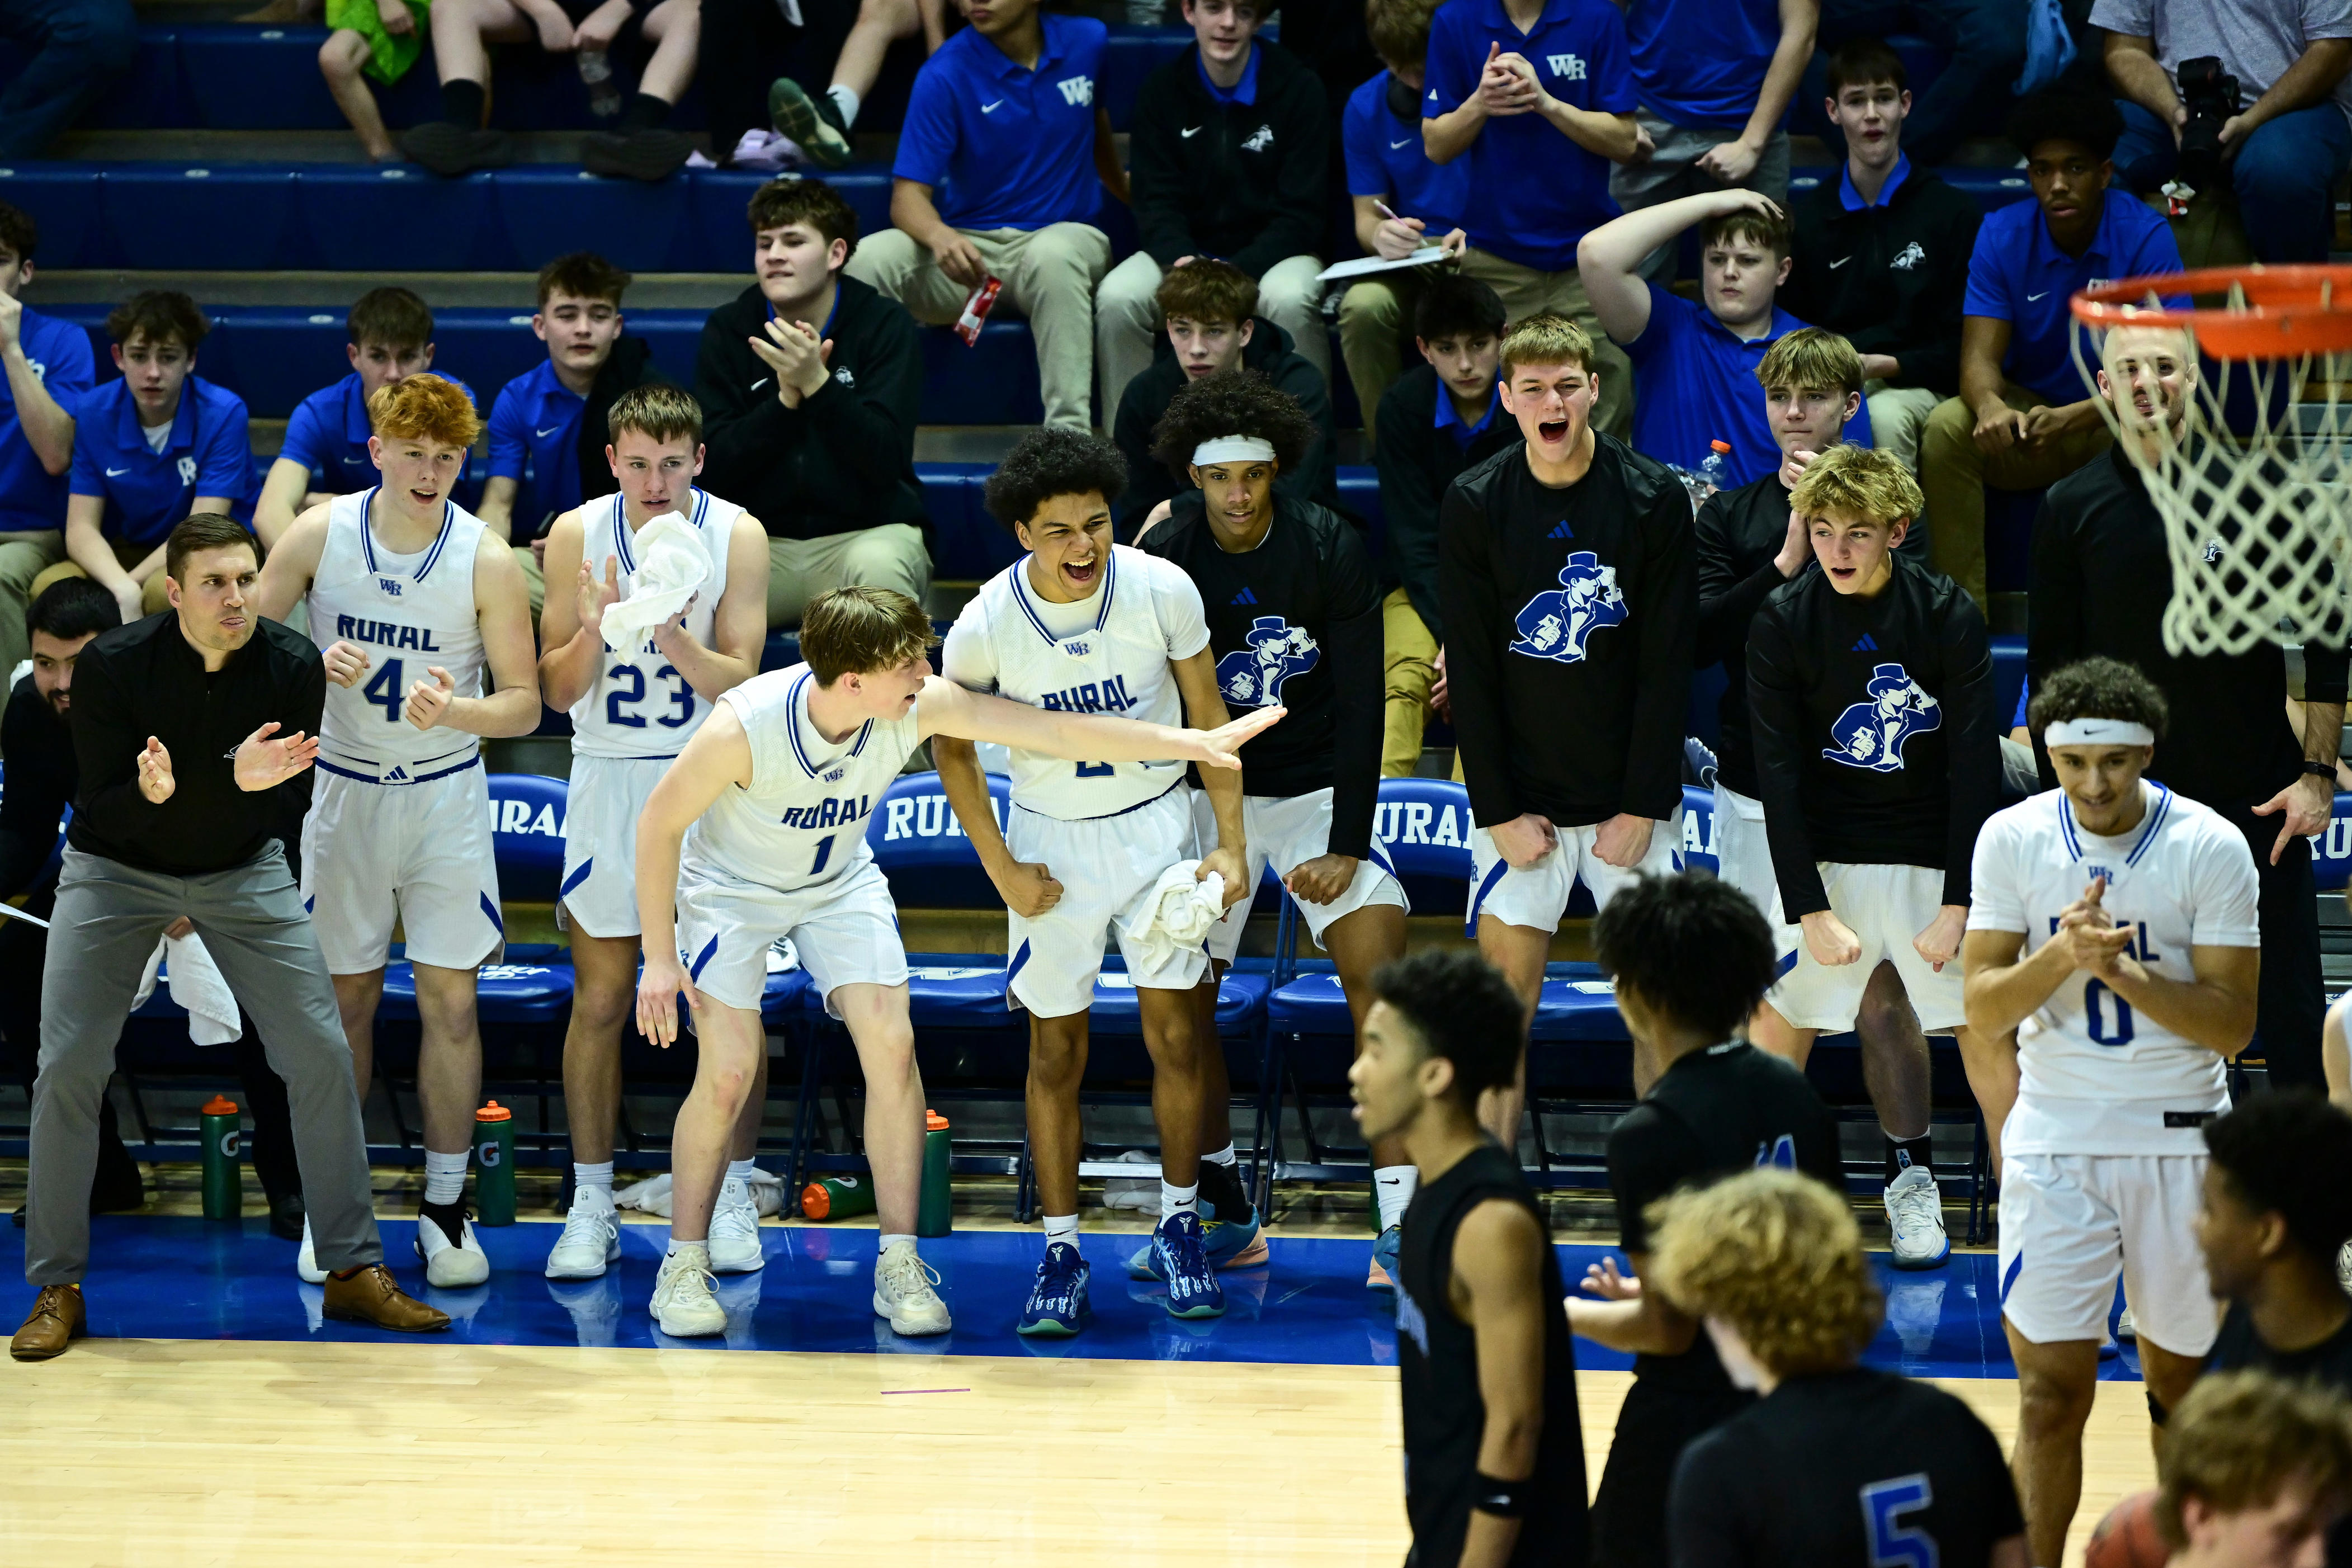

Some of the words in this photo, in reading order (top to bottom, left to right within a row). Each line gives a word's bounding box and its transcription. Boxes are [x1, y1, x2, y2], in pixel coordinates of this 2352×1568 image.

[1546, 54, 1587, 81] WR
[379, 578, 402, 596] WR
[337, 613, 440, 652] RURAL
[1062, 641, 1090, 657] WR
[362, 656, 407, 723] 4
[606, 663, 696, 729] 23
[781, 794, 873, 829] RURAL
[807, 833, 838, 877] 1
[2084, 976, 2134, 1046] 0
[478, 1141, 500, 1167] G
[1859, 1472, 1940, 1568] 5
